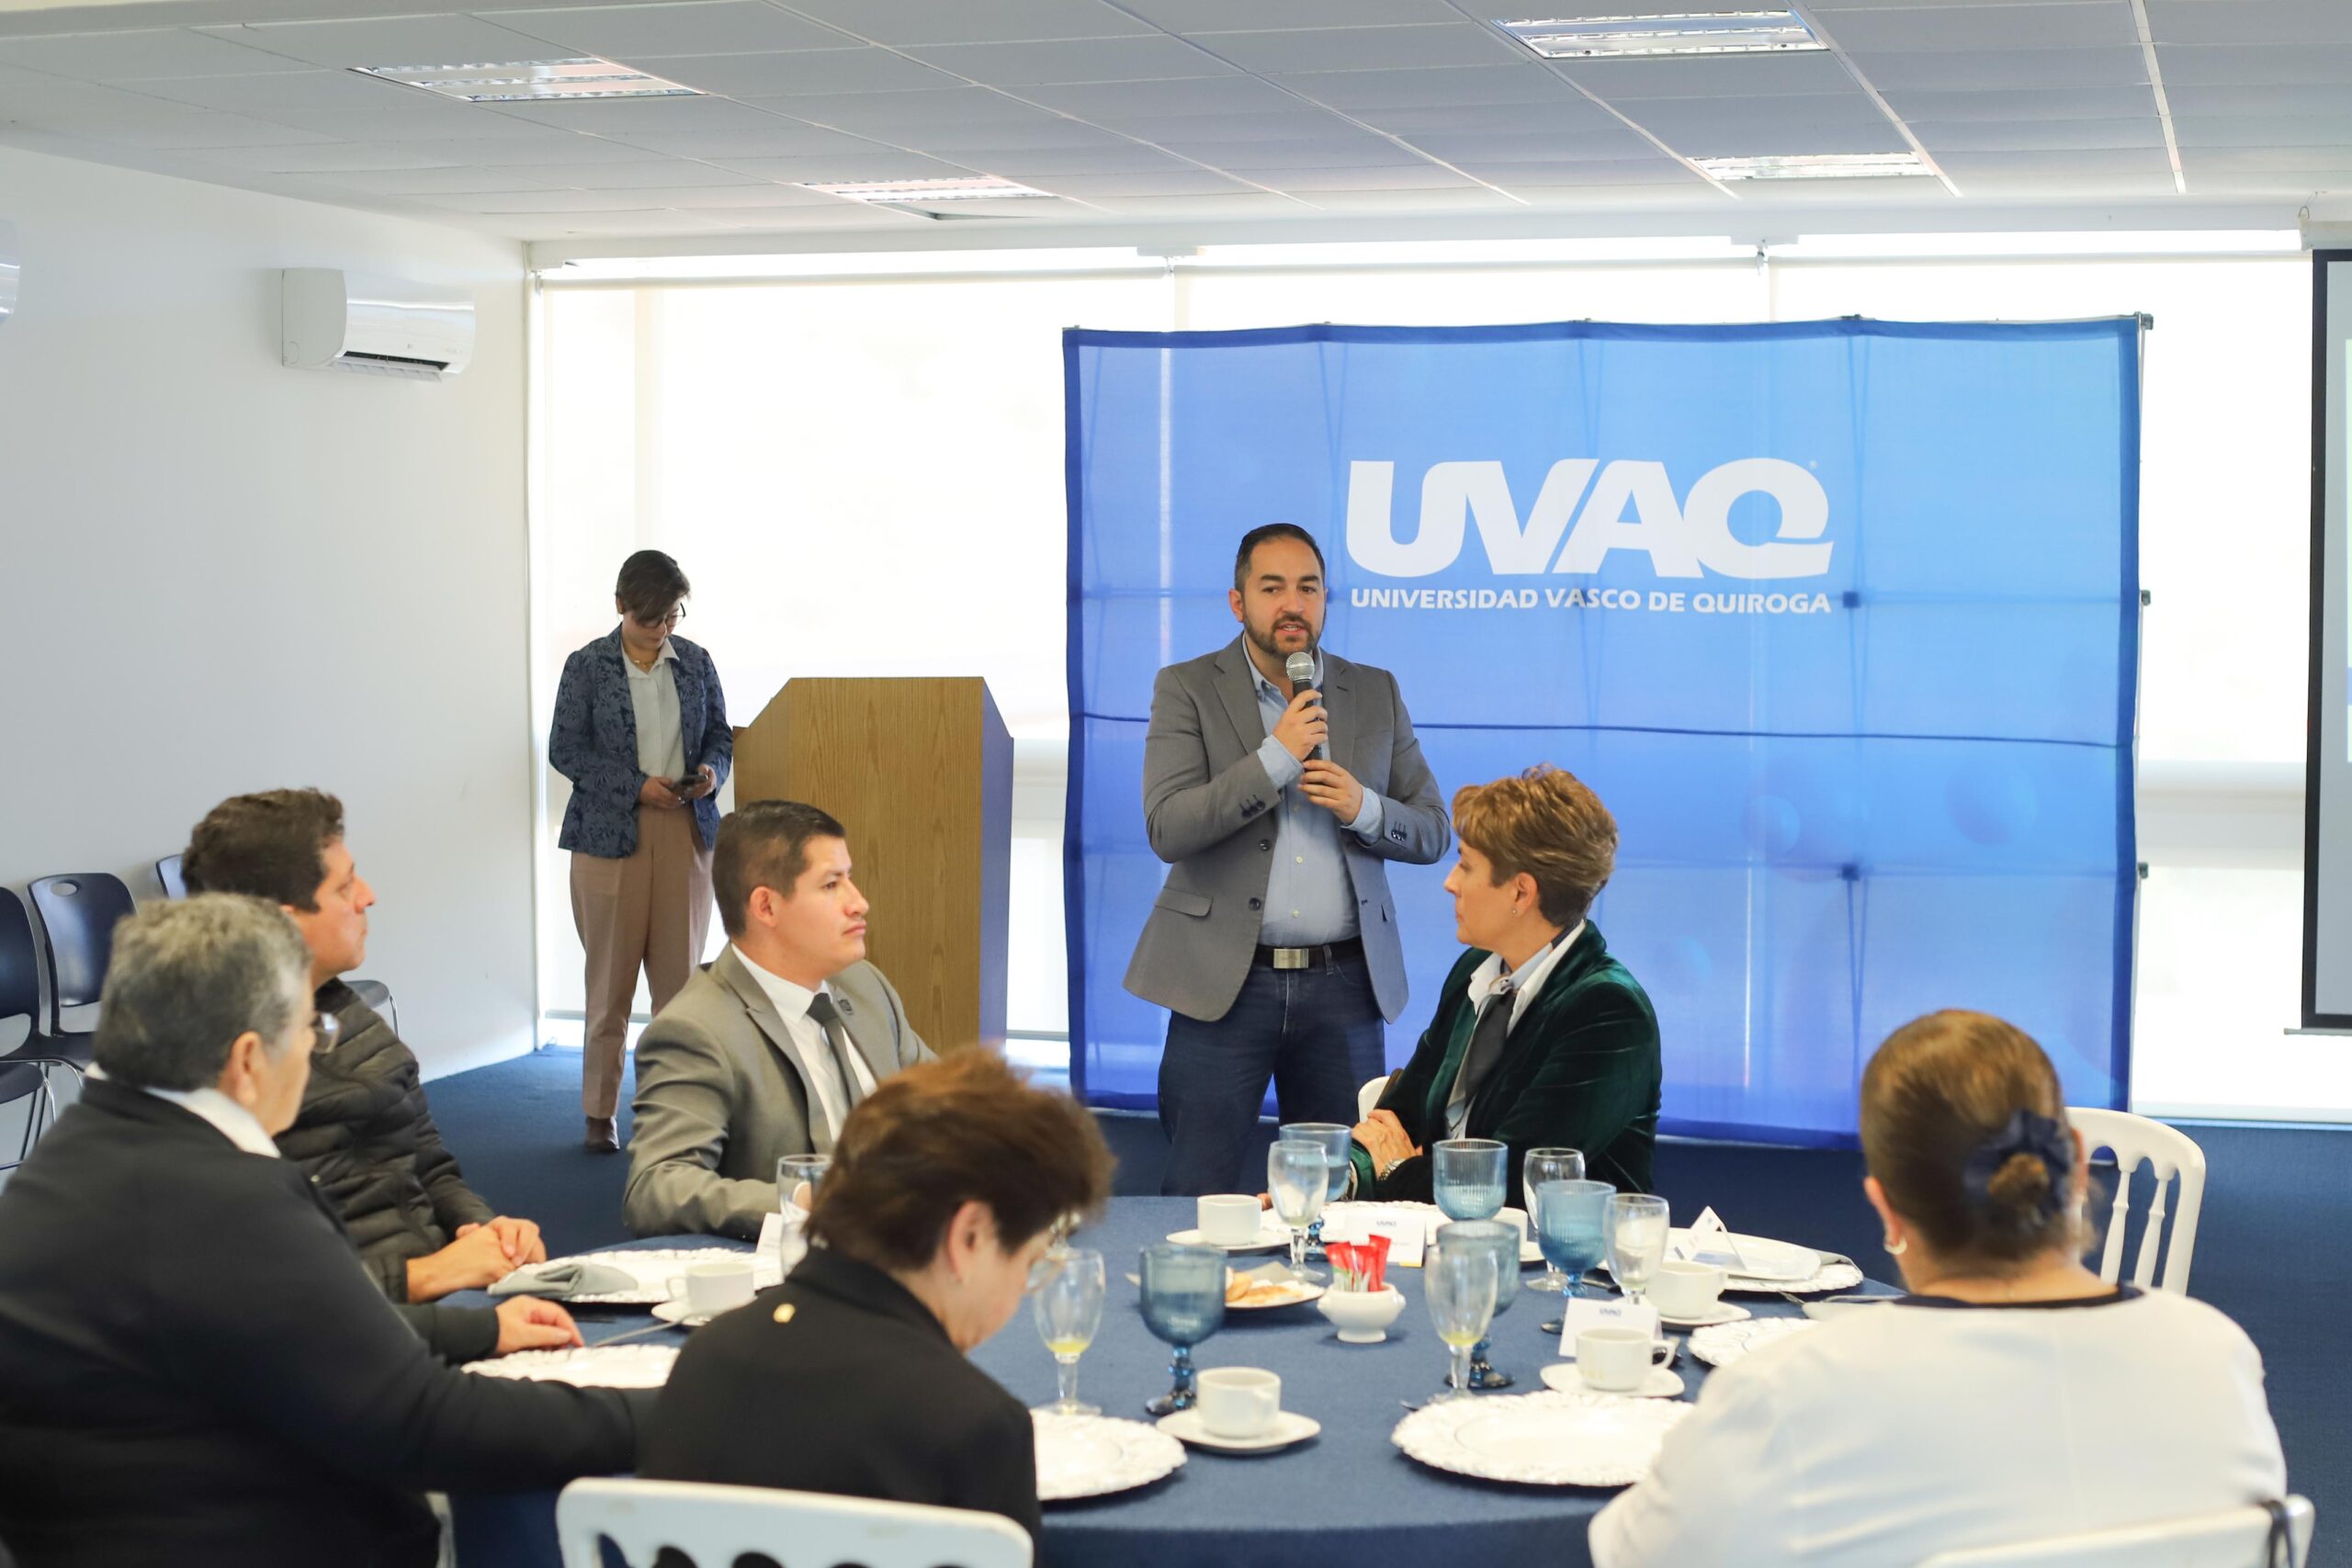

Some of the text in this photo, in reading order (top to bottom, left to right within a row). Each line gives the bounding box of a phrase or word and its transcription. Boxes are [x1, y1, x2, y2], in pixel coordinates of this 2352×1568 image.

[1346, 457, 1833, 579] UVAQ
[1351, 588, 1831, 614] UNIVERSIDAD VASCO DE QUIROGA
